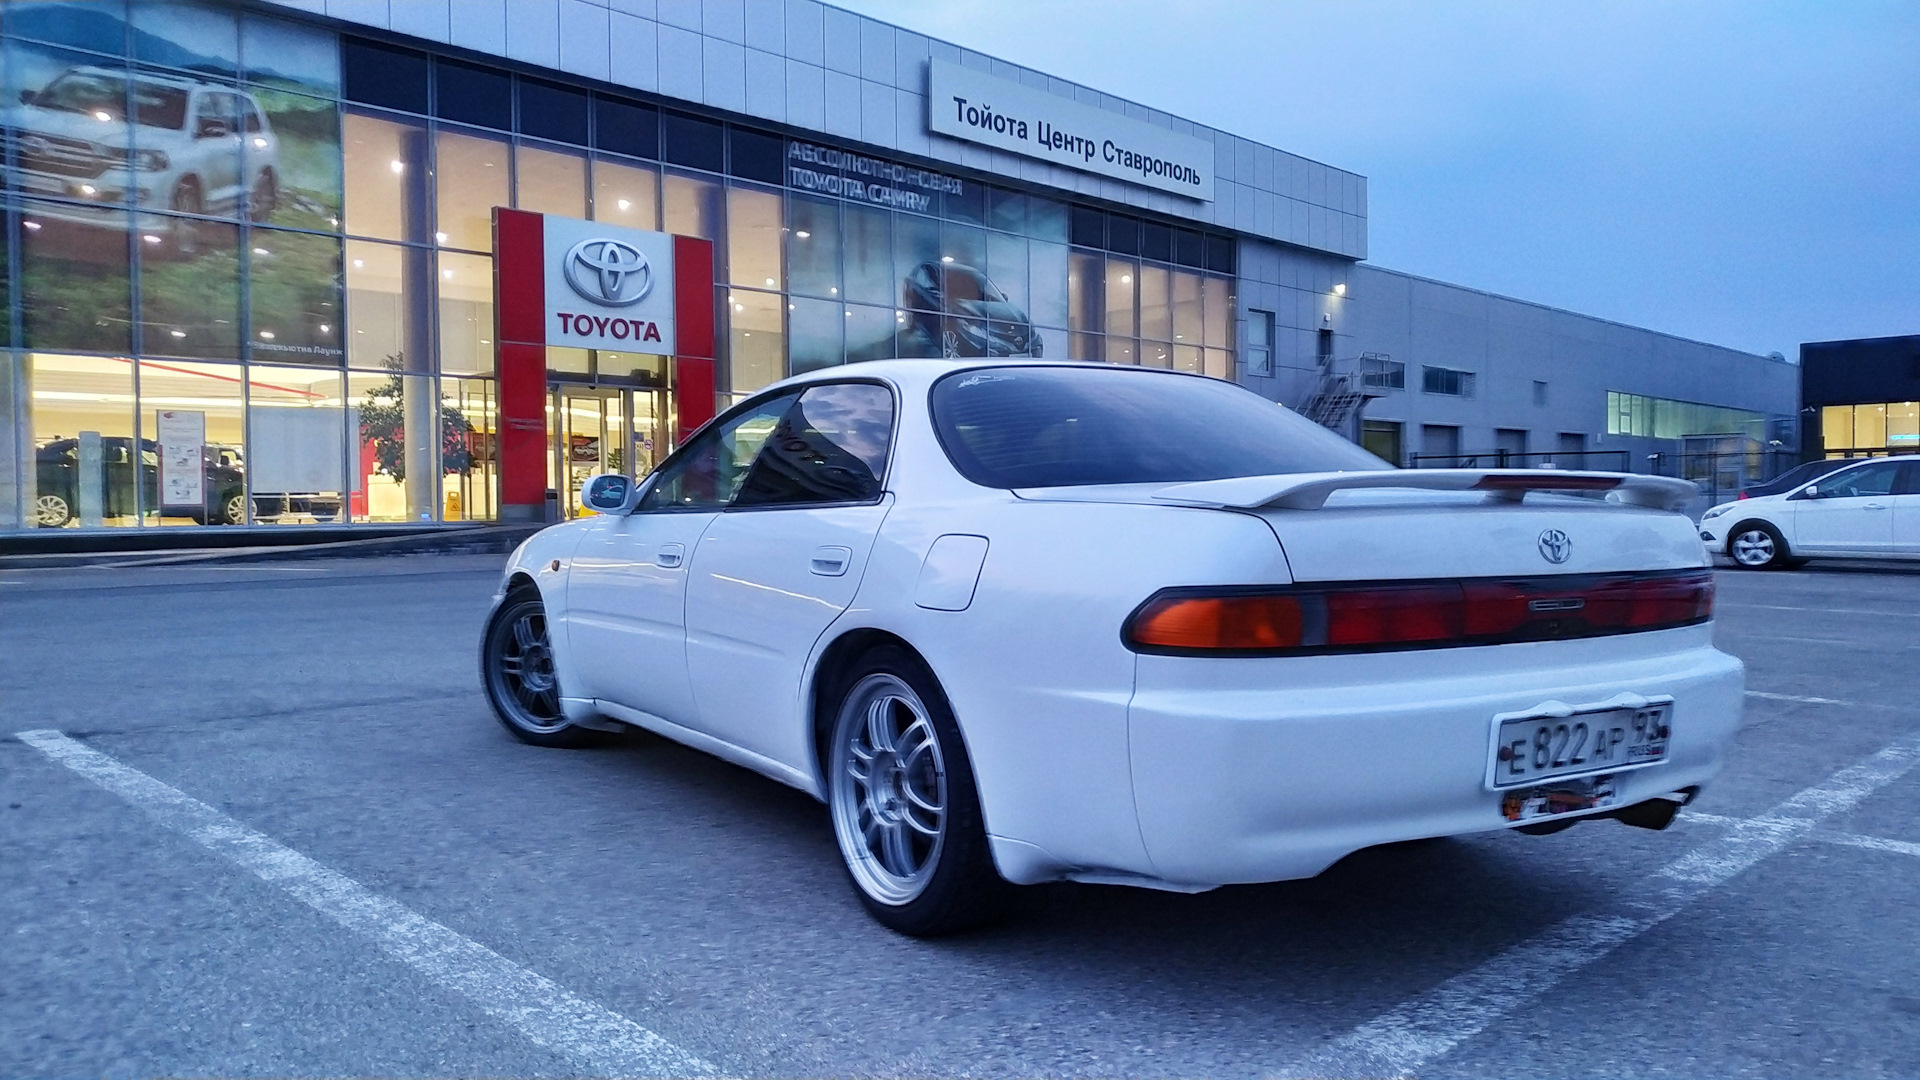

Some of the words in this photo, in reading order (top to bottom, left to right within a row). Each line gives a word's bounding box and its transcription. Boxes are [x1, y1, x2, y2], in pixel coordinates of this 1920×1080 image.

[953, 96, 1028, 140] Тойота
[1037, 120, 1096, 162] Центр
[1102, 140, 1201, 186] Ставрополь
[788, 166, 867, 200] TOYOTA
[557, 312, 662, 343] TOYOTA
